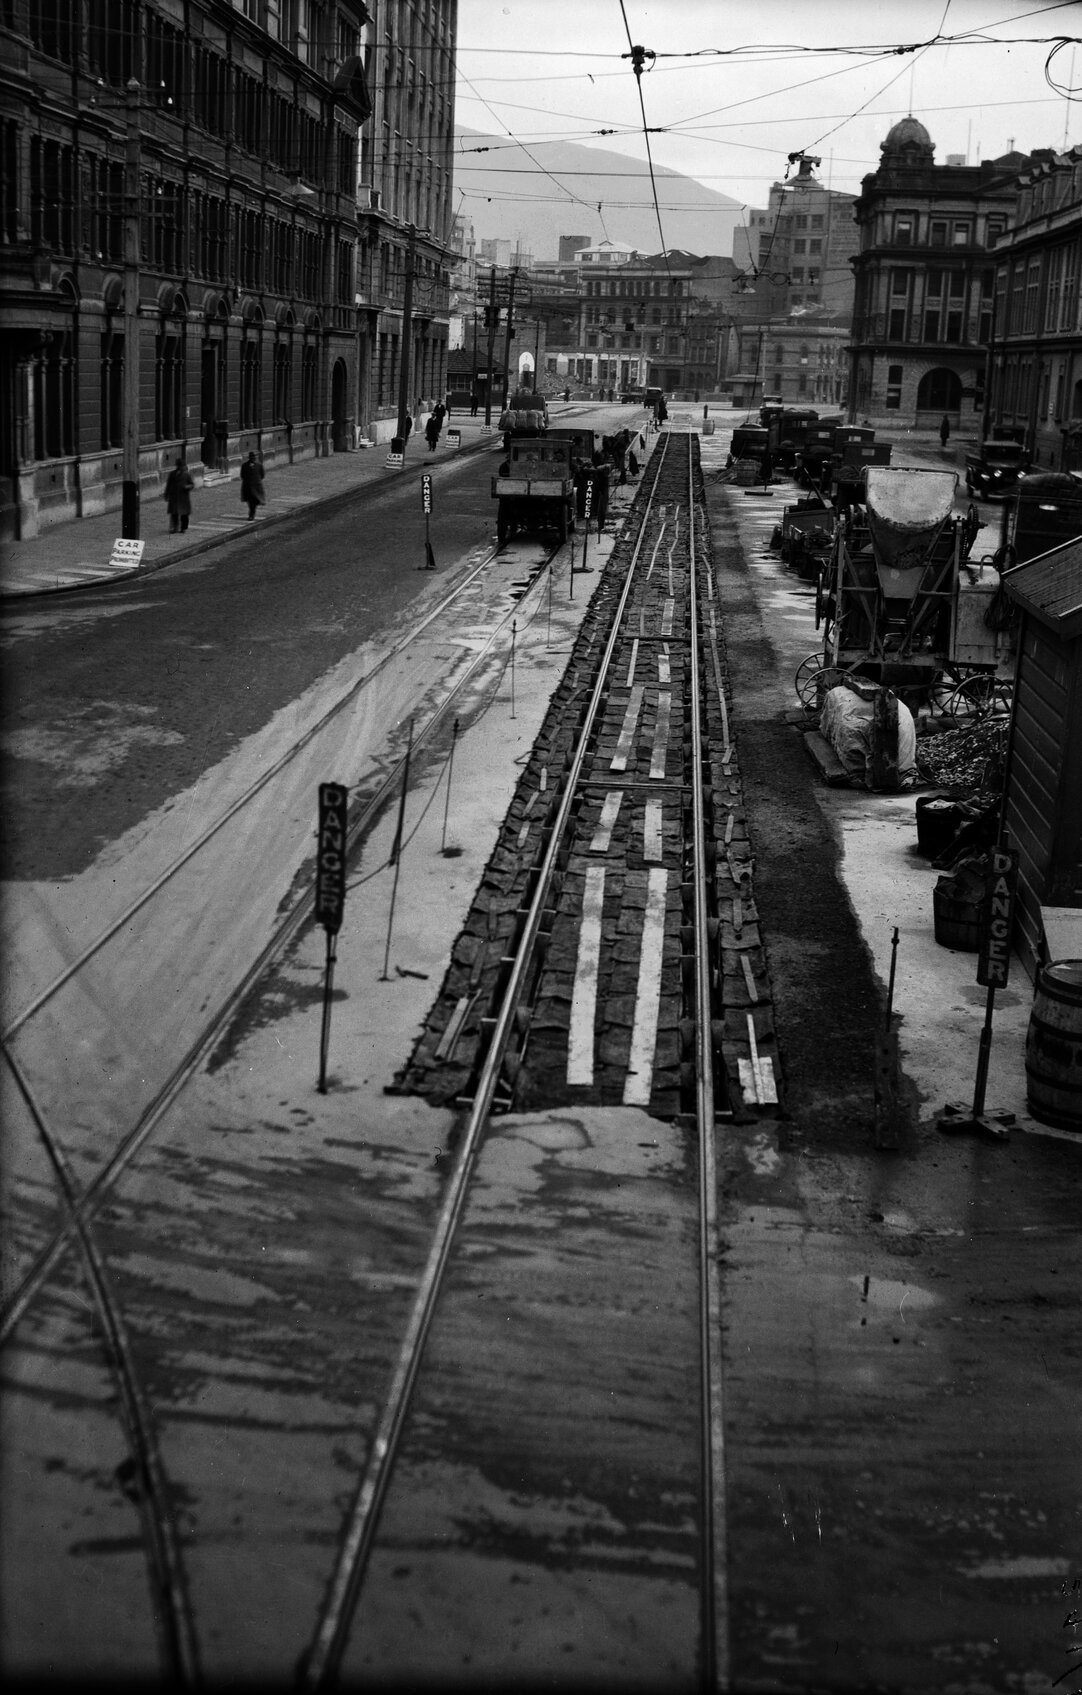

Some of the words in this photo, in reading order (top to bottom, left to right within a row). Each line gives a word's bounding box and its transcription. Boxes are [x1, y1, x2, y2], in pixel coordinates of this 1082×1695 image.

[584, 480, 593, 519] DANGER
[112, 548, 141, 556] PARKING
[118, 541, 139, 549] CAR
[321, 788, 343, 913] DANGER
[987, 853, 1012, 981] DANGER
